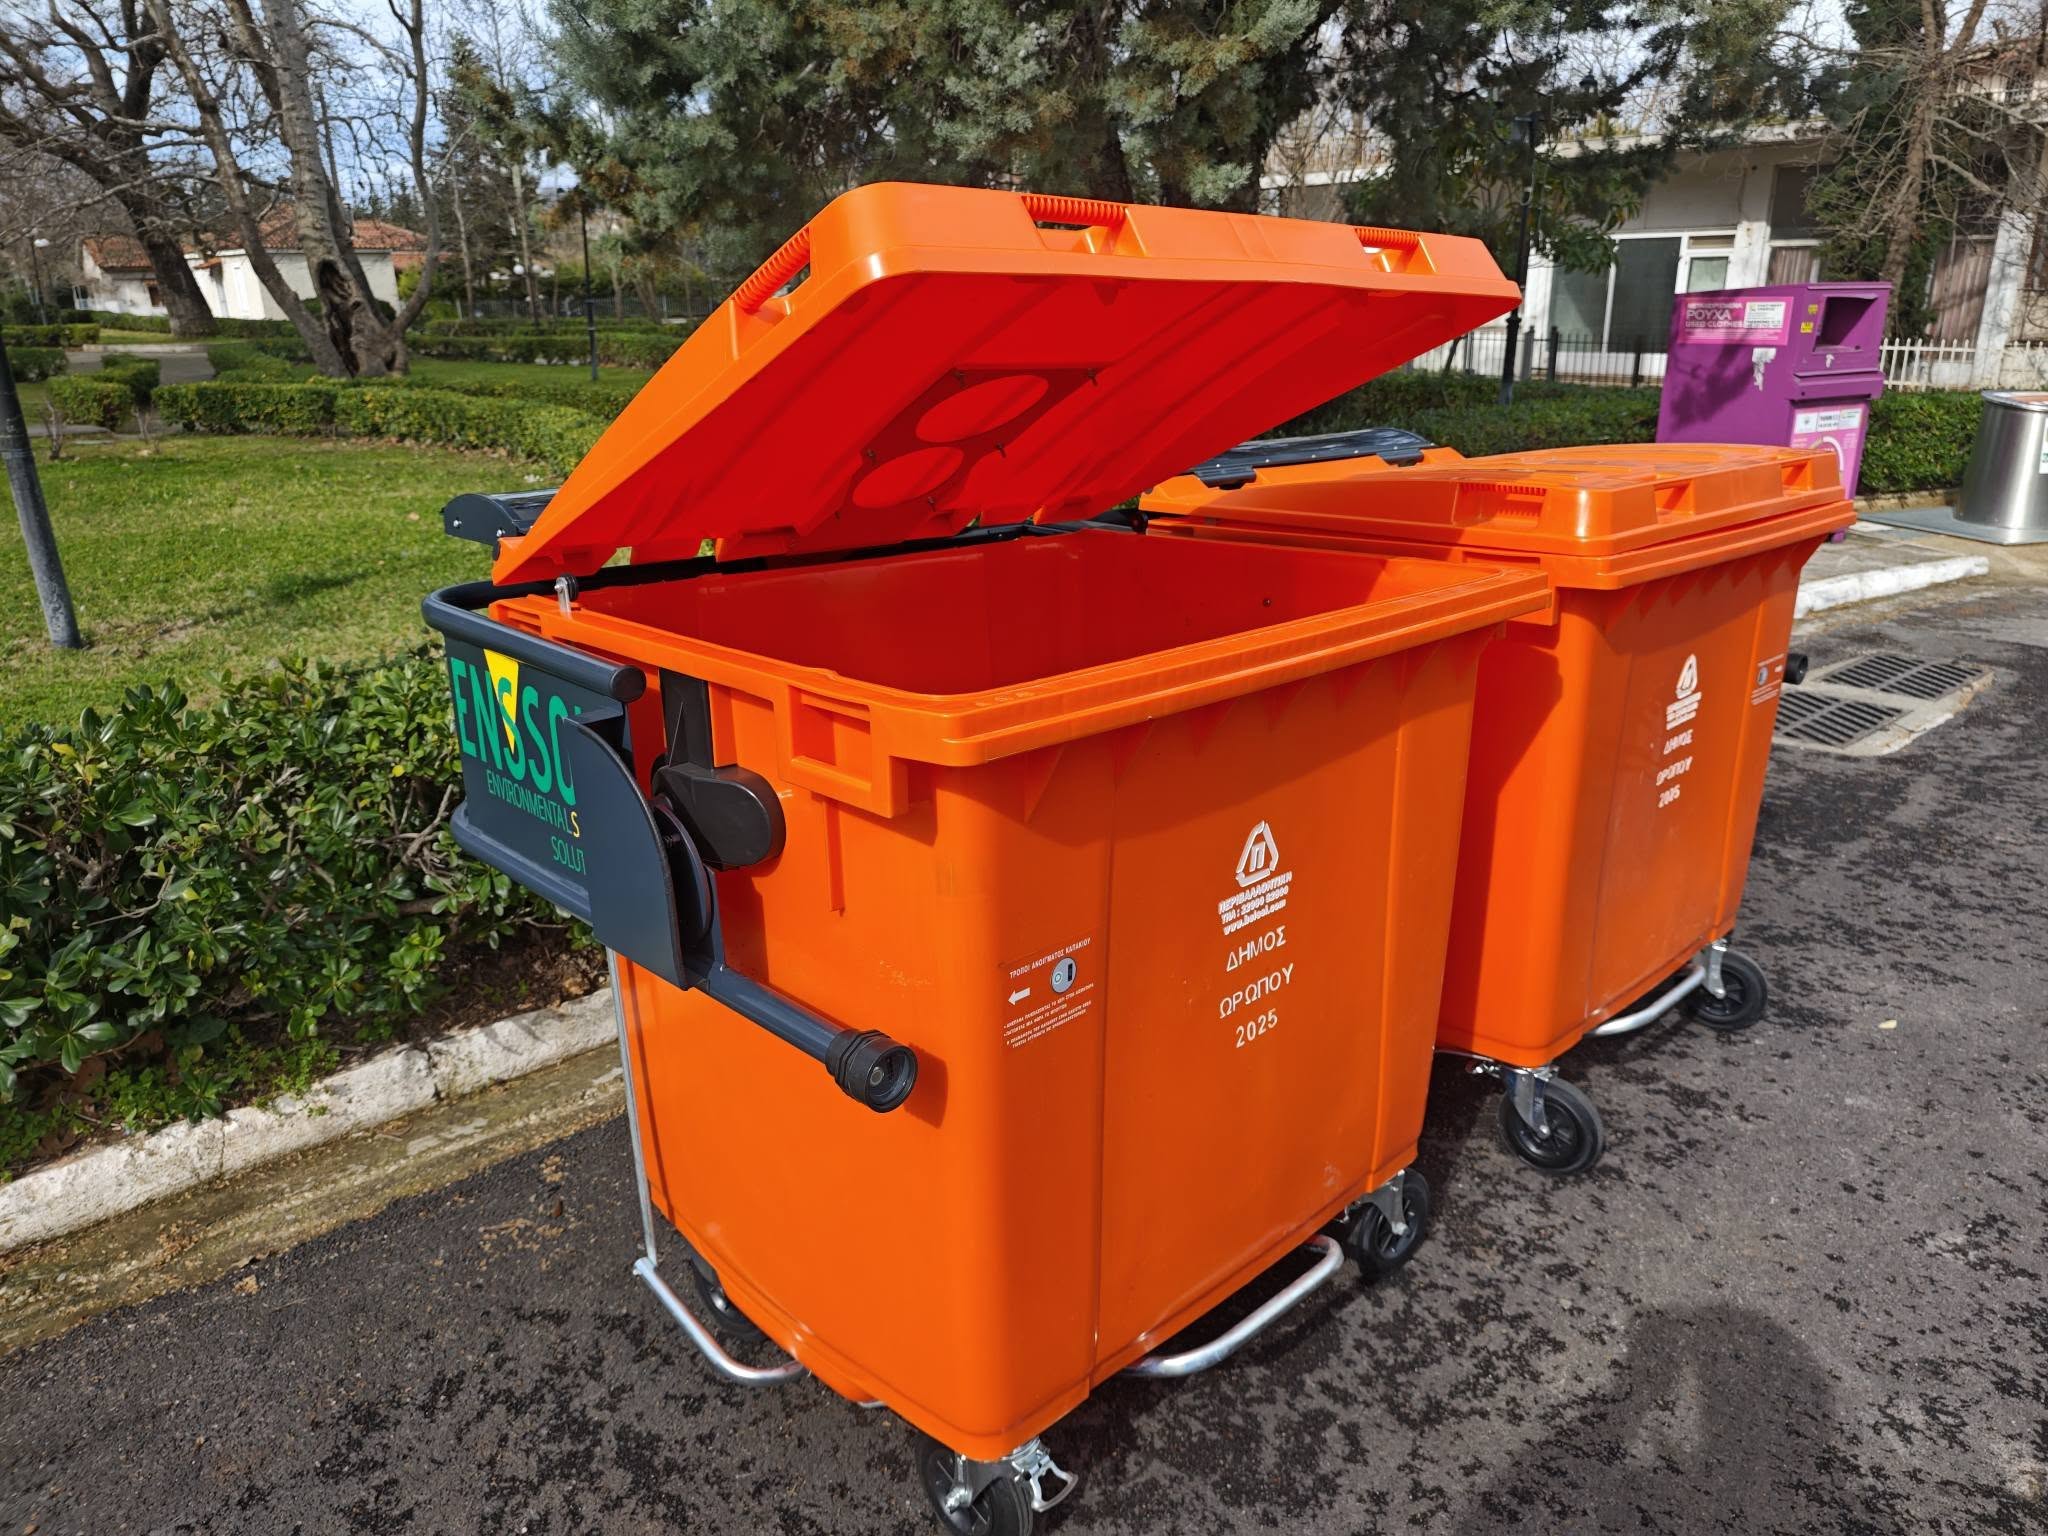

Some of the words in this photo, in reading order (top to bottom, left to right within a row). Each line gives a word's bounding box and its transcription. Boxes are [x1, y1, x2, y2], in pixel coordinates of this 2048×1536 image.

[1686, 309, 1732, 320] ΡΟΥΧΑ
[1226, 925, 1287, 972] ΔΗΜΟΣ
[1219, 963, 1294, 1019] ΩΡΩΠΟΥ
[1235, 1008, 1278, 1048] 2025
